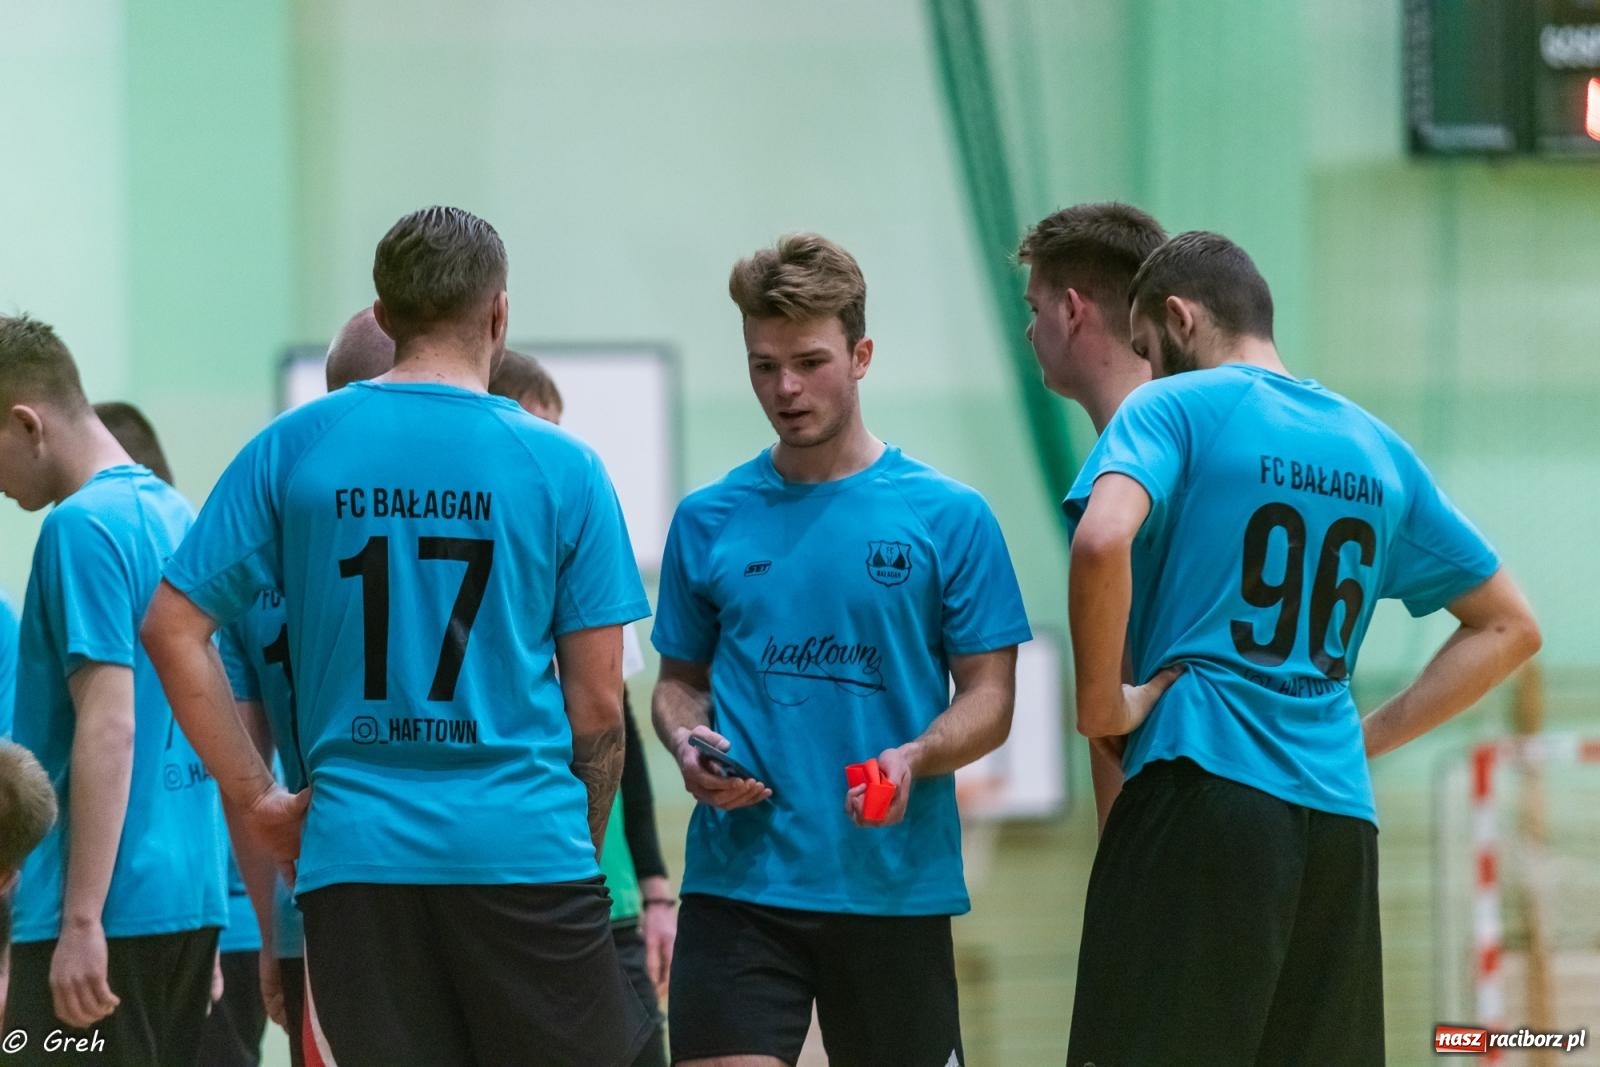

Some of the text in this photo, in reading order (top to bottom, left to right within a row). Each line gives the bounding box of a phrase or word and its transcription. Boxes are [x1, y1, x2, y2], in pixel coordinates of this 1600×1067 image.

[335, 487, 493, 521] FC BAŁAGAN
[1260, 454, 1384, 508] FC BAŁAGAN
[1229, 501, 1377, 680] 96
[338, 535, 495, 702] 17
[760, 634, 882, 675] haftown
